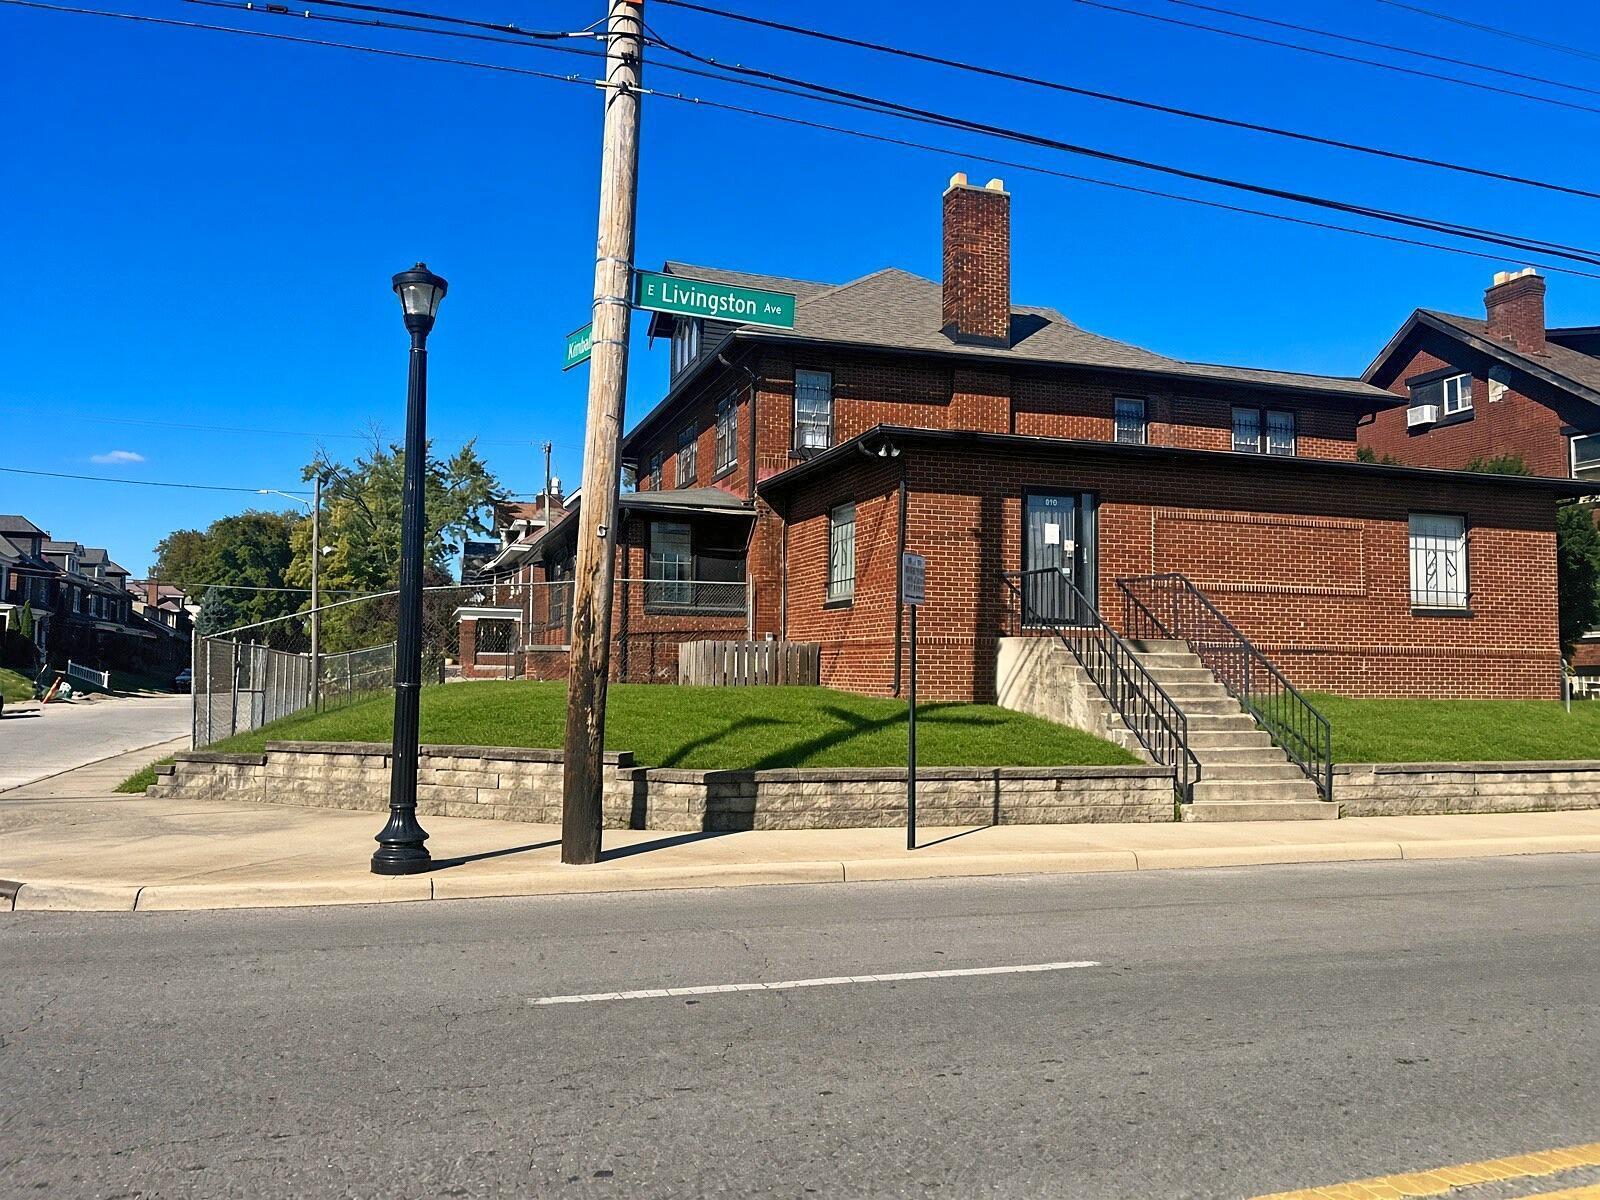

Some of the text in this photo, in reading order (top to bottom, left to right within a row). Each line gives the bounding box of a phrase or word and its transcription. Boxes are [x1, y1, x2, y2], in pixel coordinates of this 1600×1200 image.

[648, 283, 782, 315] E Livingston Ave
